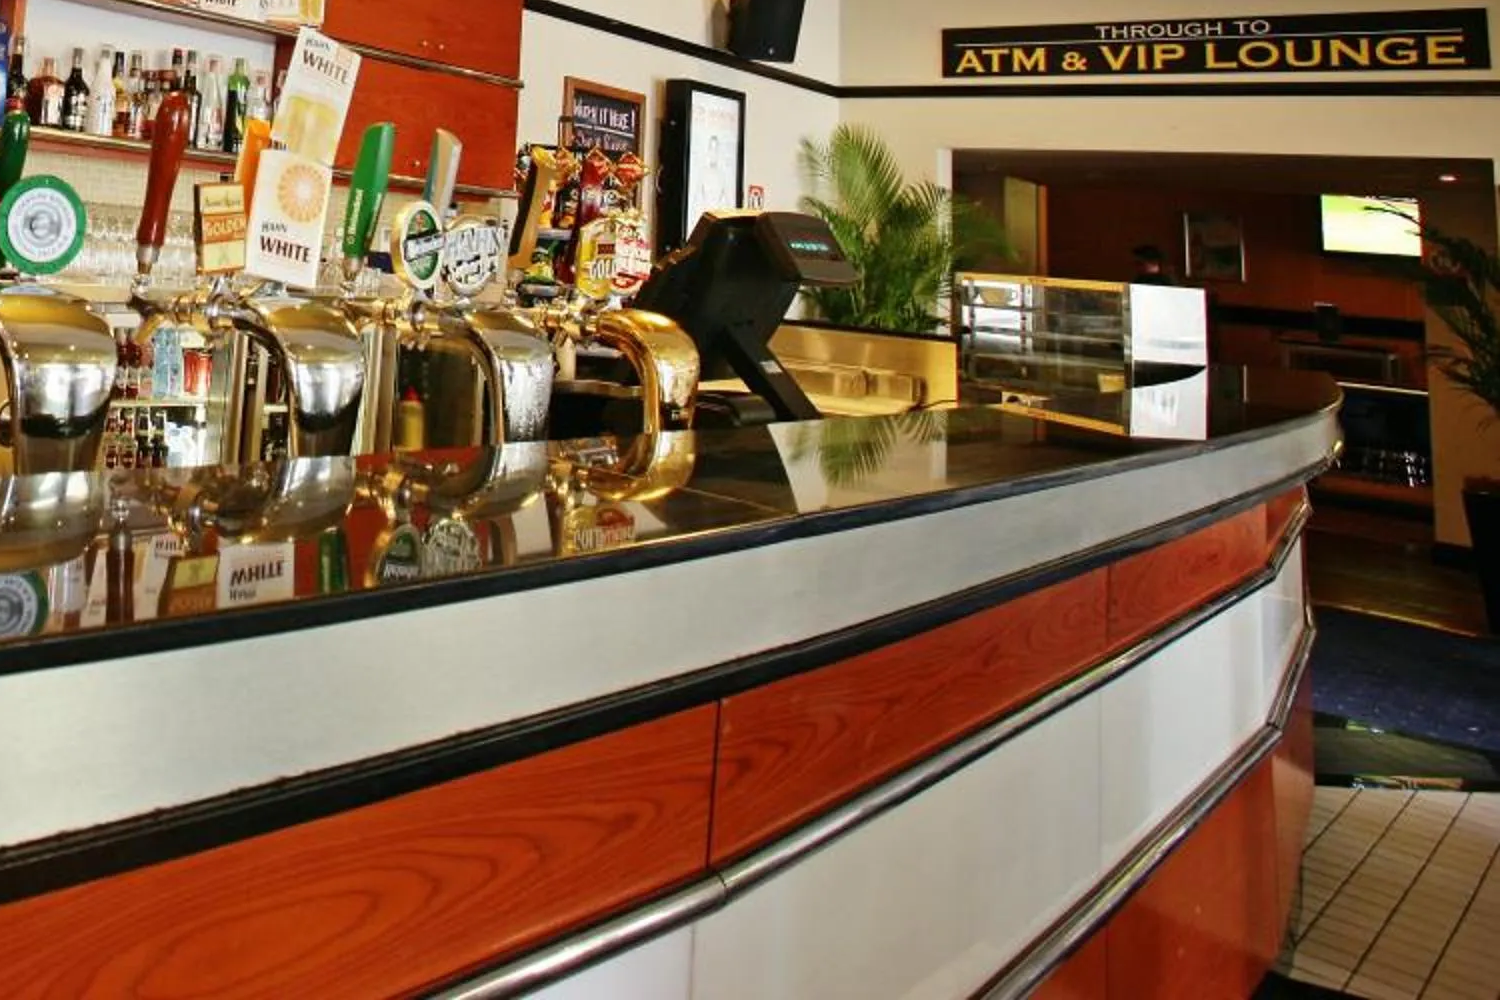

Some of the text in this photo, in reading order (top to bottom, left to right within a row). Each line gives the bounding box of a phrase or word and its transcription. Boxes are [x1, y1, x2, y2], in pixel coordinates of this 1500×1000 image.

[1096, 19, 1270, 40] THROUGH TO
[302, 50, 348, 85] WHITE
[956, 35, 1465, 73] ATM & VIP LOUNGE
[260, 235, 310, 263] WHITE
